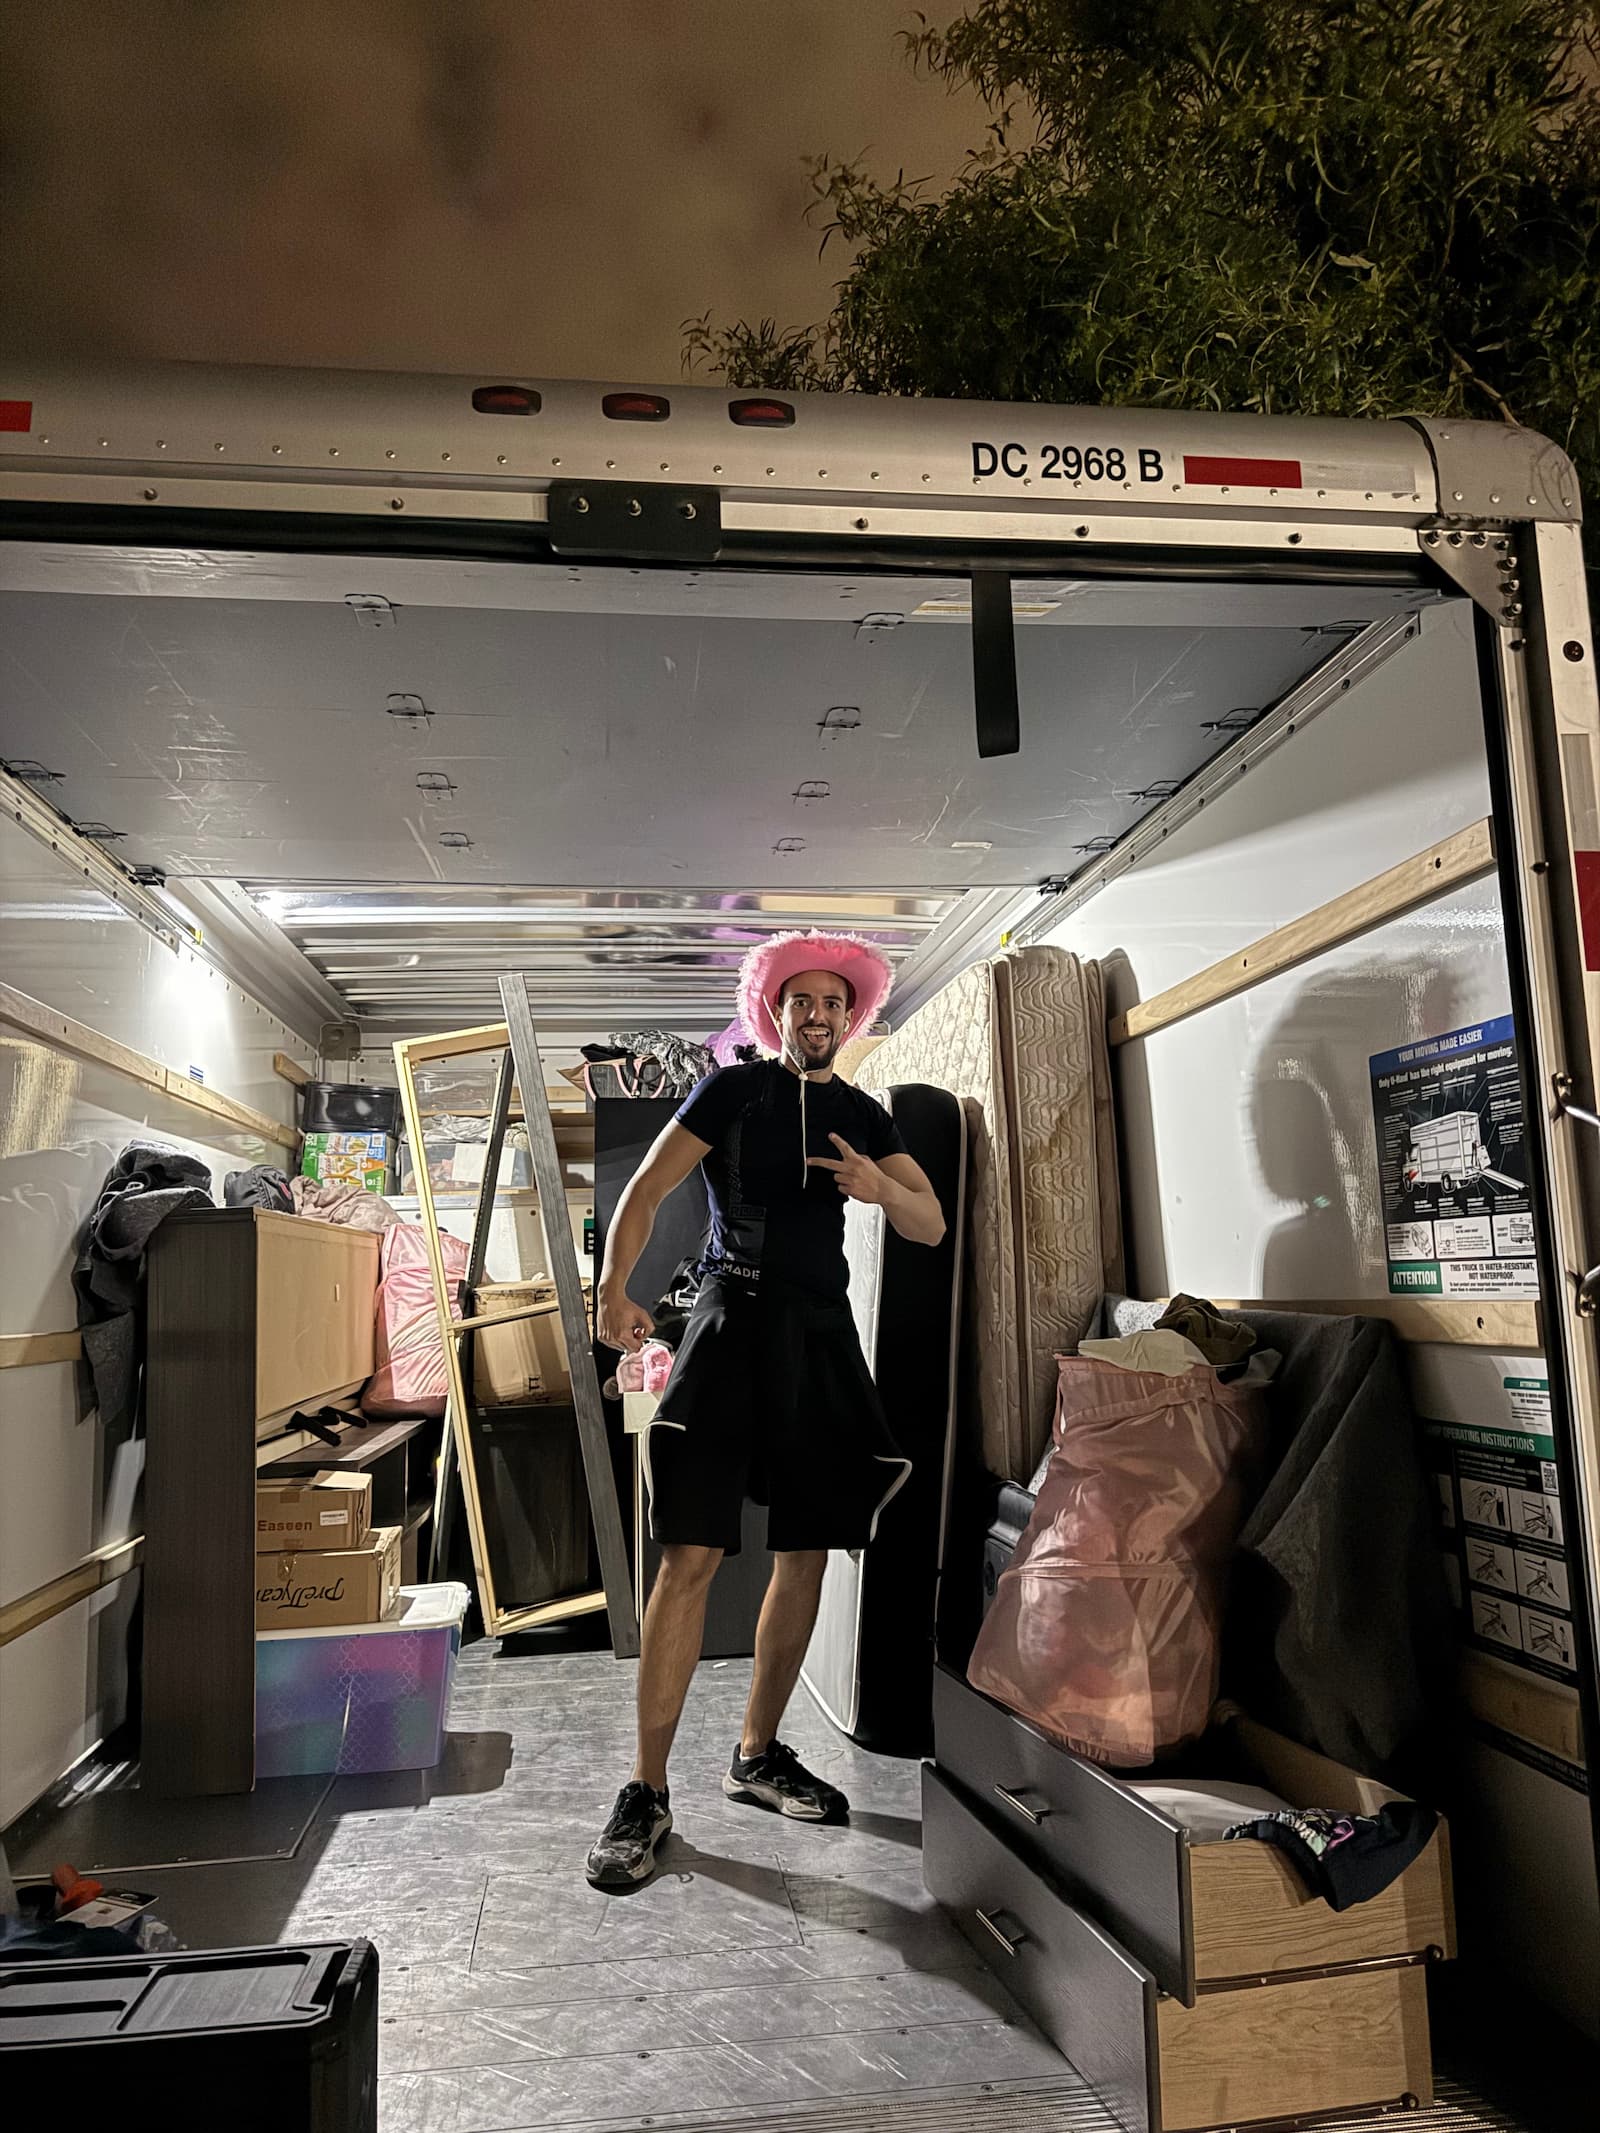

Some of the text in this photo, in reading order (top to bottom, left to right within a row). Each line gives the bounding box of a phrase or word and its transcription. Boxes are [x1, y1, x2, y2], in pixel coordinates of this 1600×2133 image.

[972, 442, 1164, 482] DC 2968 B
[1398, 1029, 1483, 1063] YOUR MOVING MADE EASIER
[1445, 1055, 1476, 1072] equipment
[1477, 1052, 1486, 1063] for
[722, 1262, 761, 1280] MADE
[1450, 1264, 1461, 1272] THIS
[1462, 1263, 1478, 1271] TRUCK
[1468, 1272, 1479, 1280] NOT
[1392, 1270, 1438, 1286] ATTENTION
[1443, 1426, 1480, 1444] OPERATING
[1481, 1431, 1535, 1452] INSTRUCTIONS
